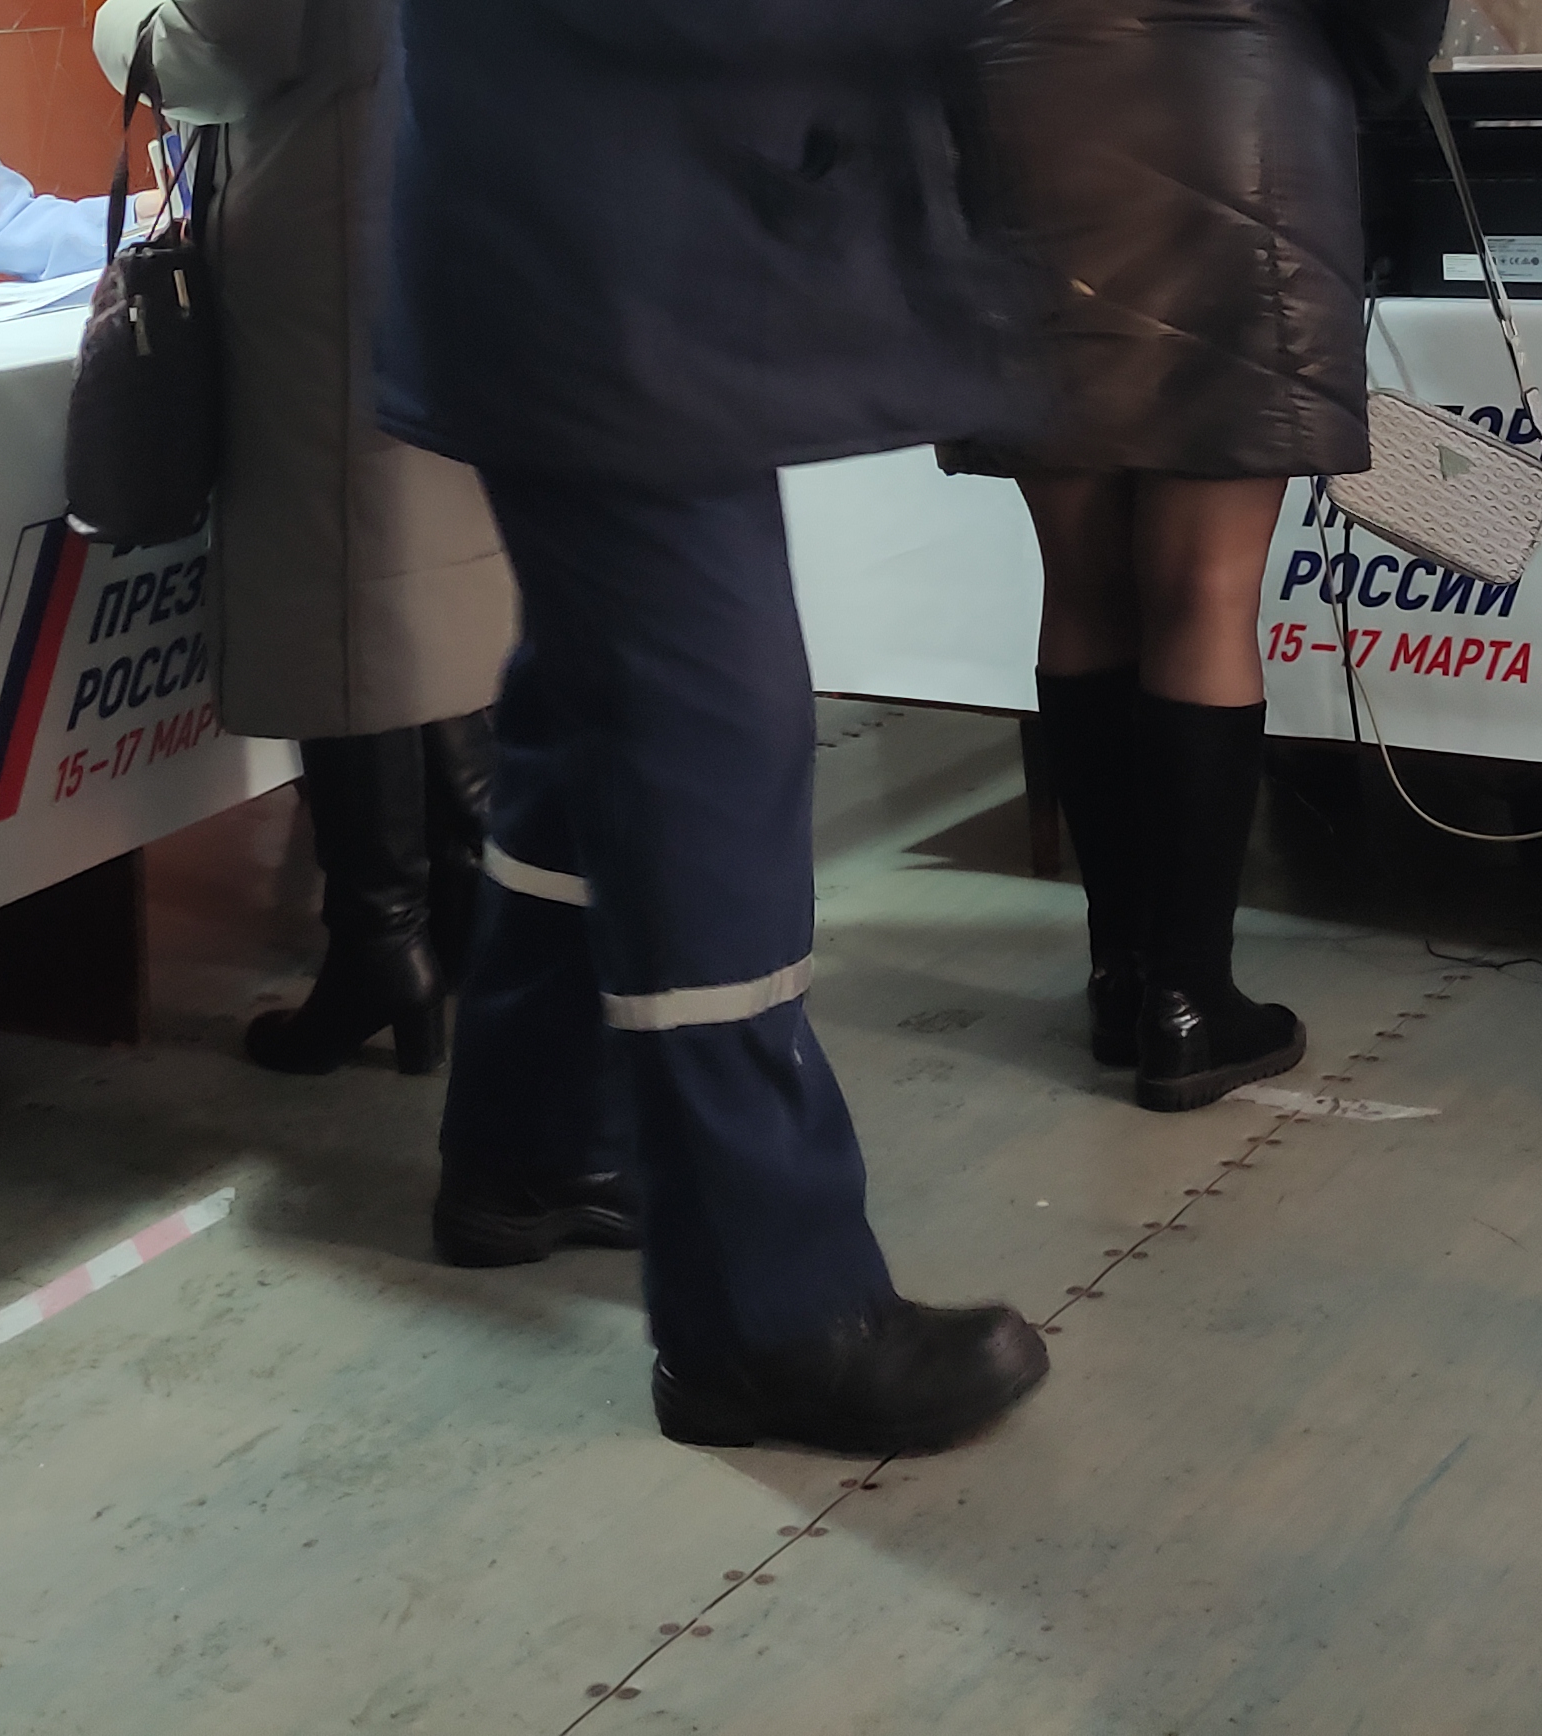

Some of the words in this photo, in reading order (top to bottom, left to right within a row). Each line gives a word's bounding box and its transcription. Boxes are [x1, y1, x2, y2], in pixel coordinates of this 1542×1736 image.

[1279, 549, 1524, 618] РОССИИ
[66, 631, 209, 732] РОССИ
[1389, 632, 1531, 684] МАРТА
[148, 700, 225, 763] МАР
